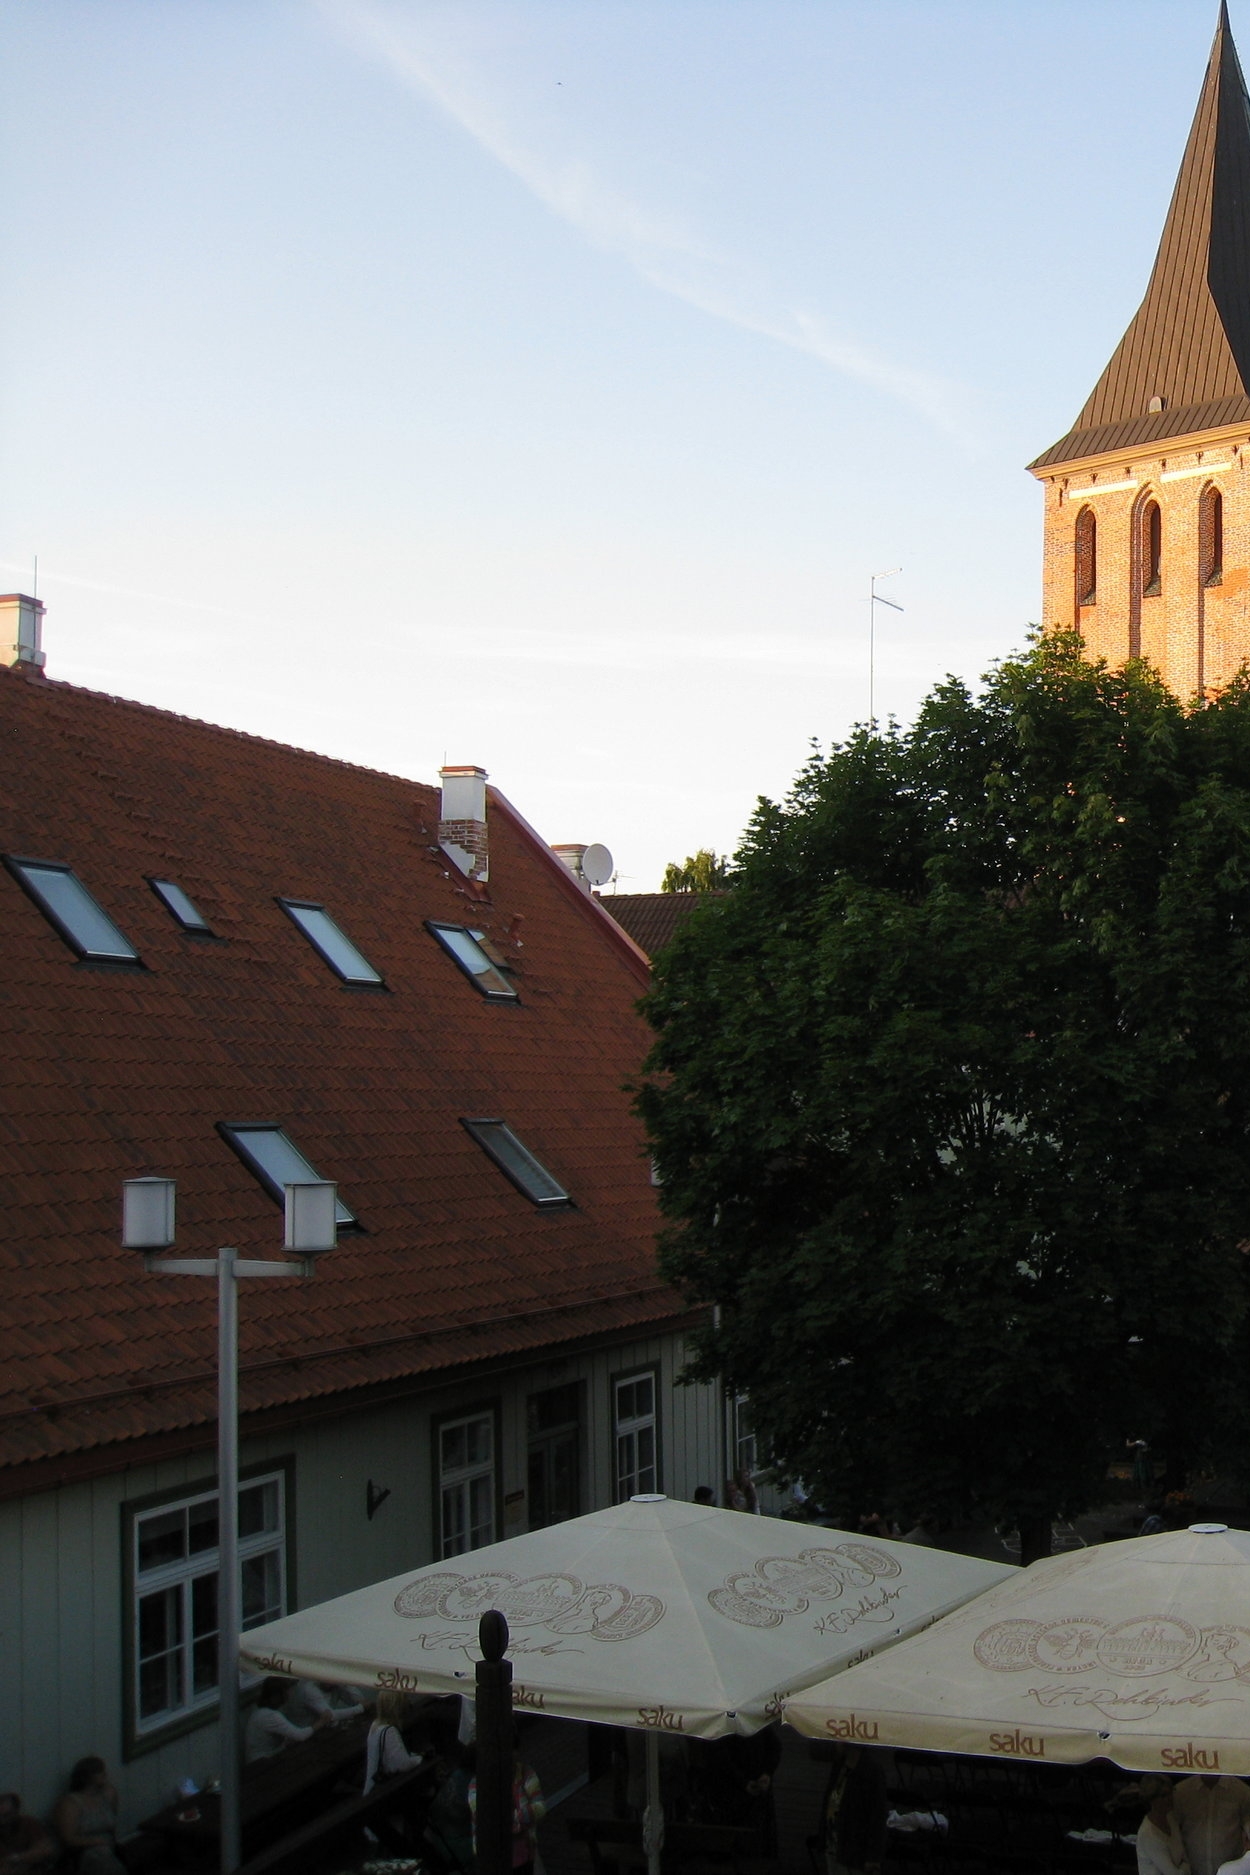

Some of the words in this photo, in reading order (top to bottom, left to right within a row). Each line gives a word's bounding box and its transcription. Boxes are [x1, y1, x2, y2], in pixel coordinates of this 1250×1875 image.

[375, 1668, 418, 1692] saku
[512, 1685, 545, 1709] aku
[636, 1705, 684, 1731] saku
[825, 1712, 880, 1740] saku
[990, 1729, 1044, 1756] saku
[1161, 1742, 1220, 1769] saku
